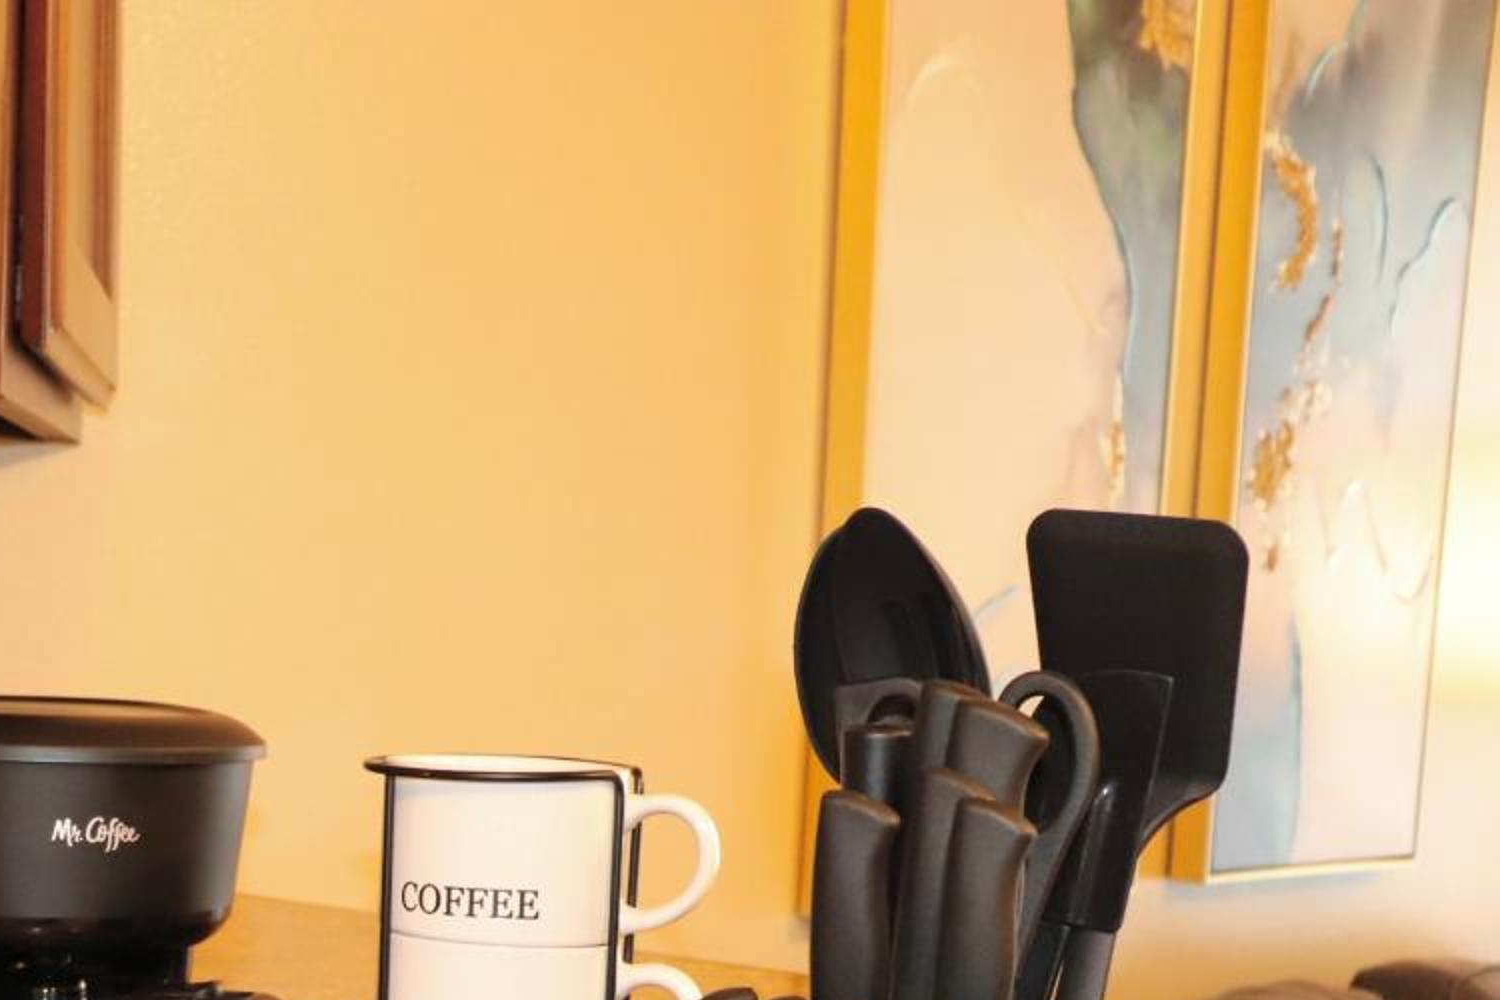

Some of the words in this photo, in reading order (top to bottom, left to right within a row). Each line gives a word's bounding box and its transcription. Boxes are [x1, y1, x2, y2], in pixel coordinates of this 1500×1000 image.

[51, 817, 84, 847] Mr.
[85, 816, 141, 853] Coffee
[400, 880, 540, 922] COFFEE
